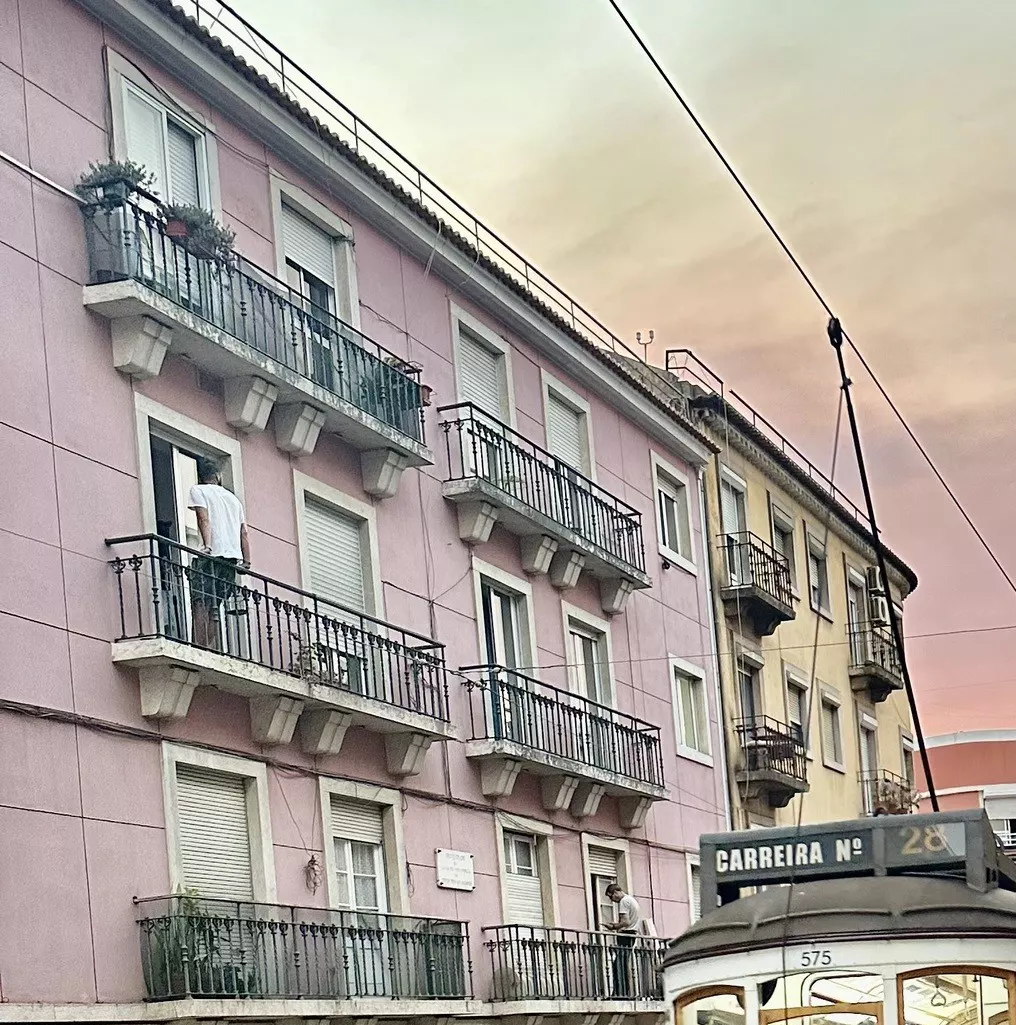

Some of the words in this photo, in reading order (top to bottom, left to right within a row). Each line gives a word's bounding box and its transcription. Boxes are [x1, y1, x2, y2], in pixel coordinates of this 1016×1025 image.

[716, 841, 824, 873] CARREIRA
[902, 824, 947, 855] 28
[801, 950, 832, 967] 575
